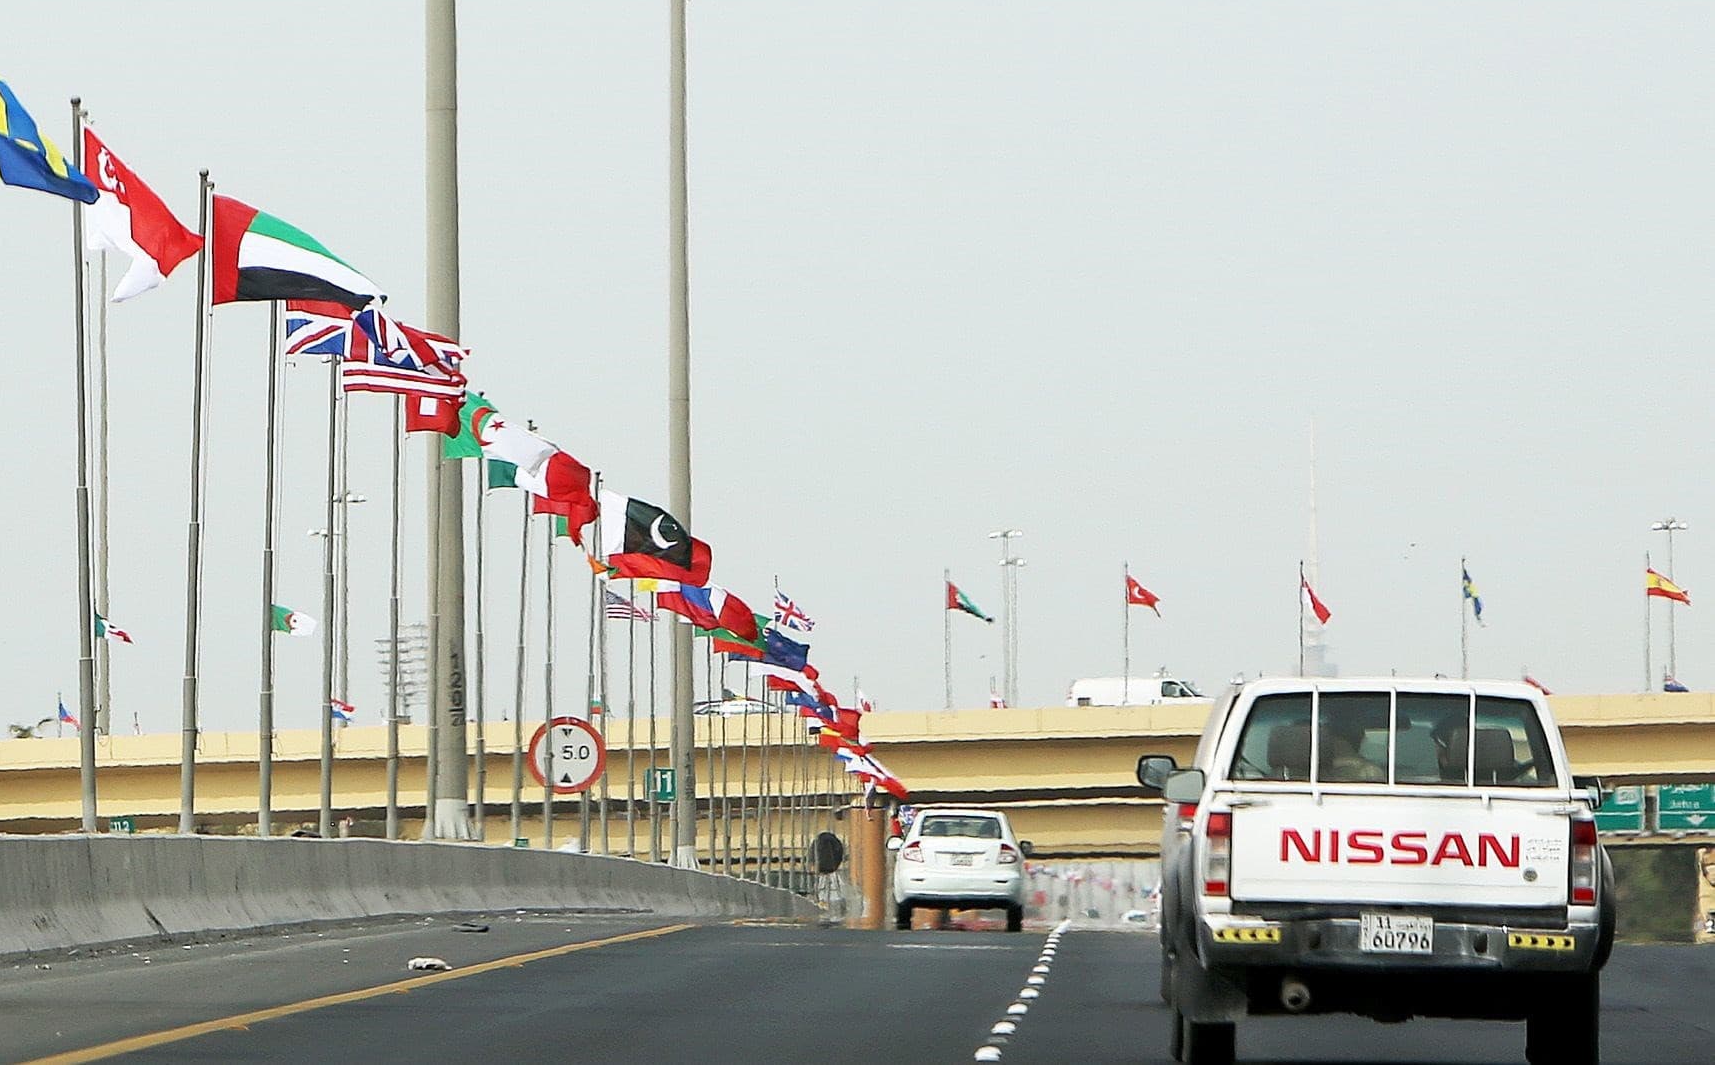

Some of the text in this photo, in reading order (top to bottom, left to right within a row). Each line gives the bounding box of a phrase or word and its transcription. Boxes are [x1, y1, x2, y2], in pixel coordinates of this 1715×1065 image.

[562, 745, 590, 760] 5.0
[1279, 828, 1520, 868] NISSAN
[1373, 931, 1430, 950] 60796
